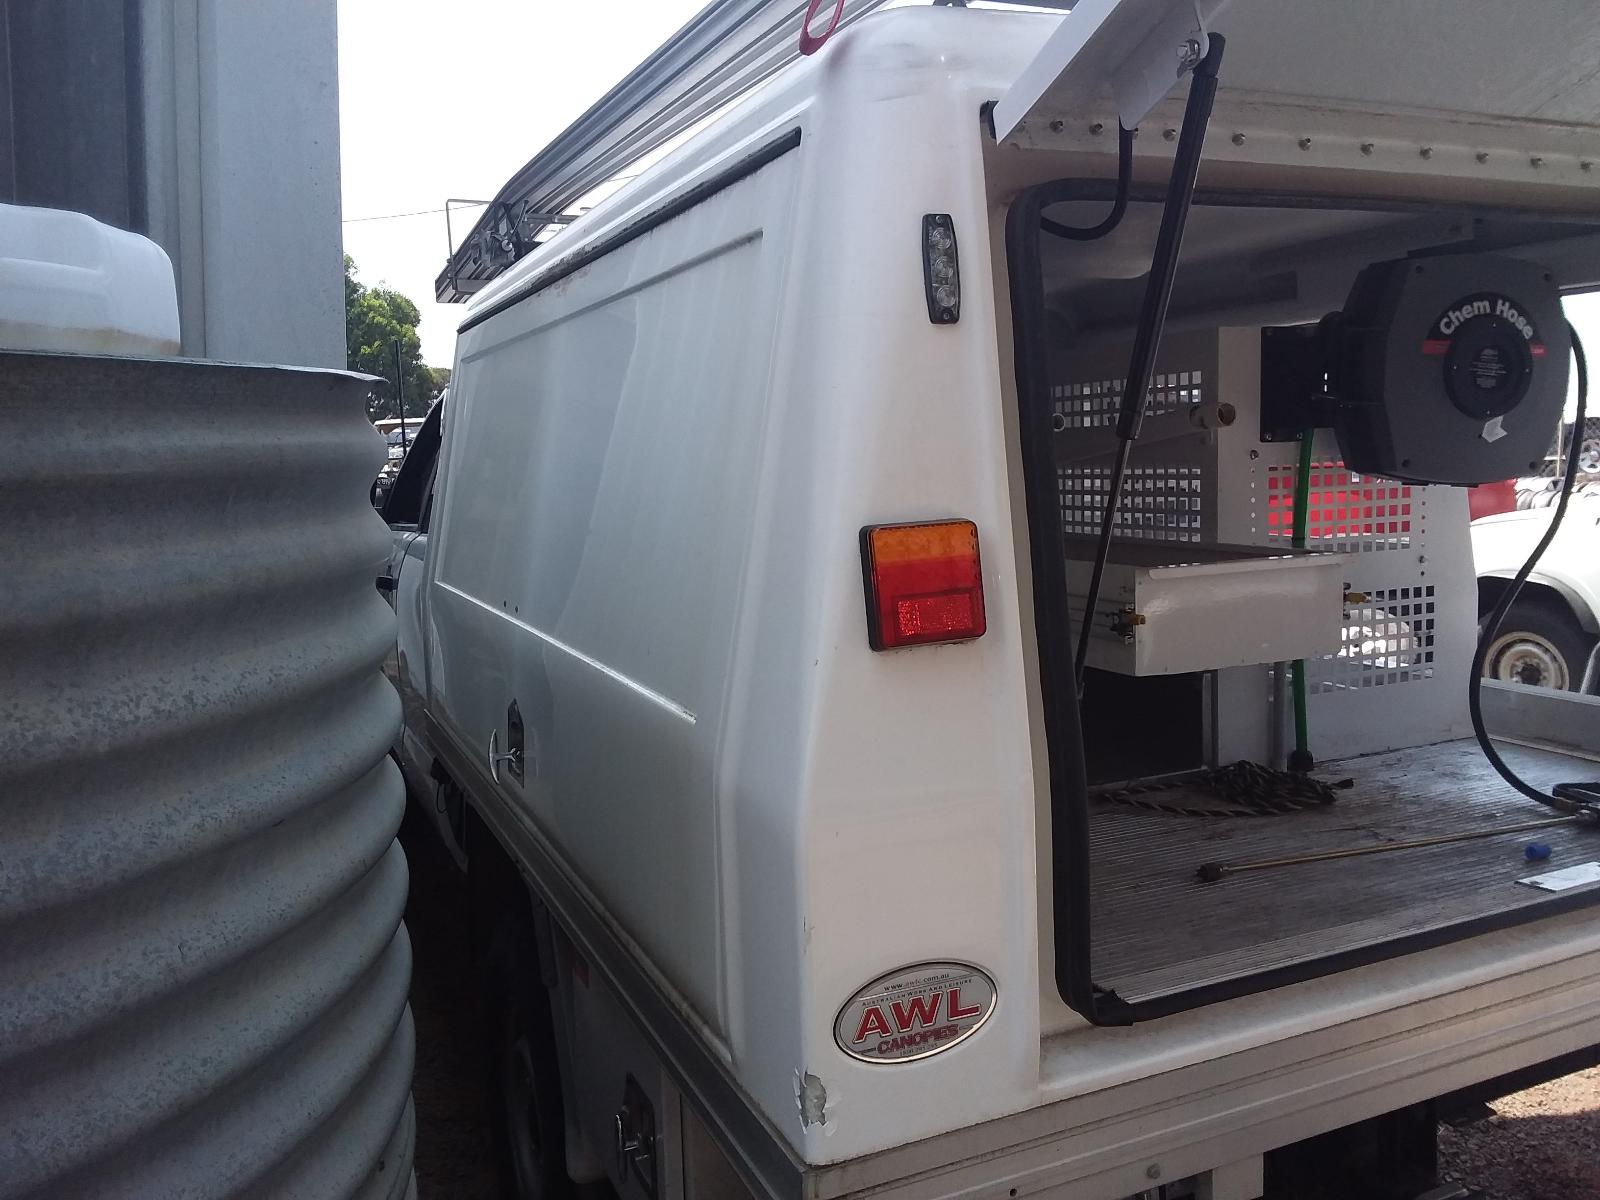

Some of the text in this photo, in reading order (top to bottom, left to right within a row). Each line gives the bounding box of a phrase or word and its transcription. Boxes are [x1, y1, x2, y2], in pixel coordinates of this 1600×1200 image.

[1440, 299, 1534, 339] Chem Hose
[853, 987, 982, 1044] AWL
[876, 1023, 959, 1055] CANOPIES
